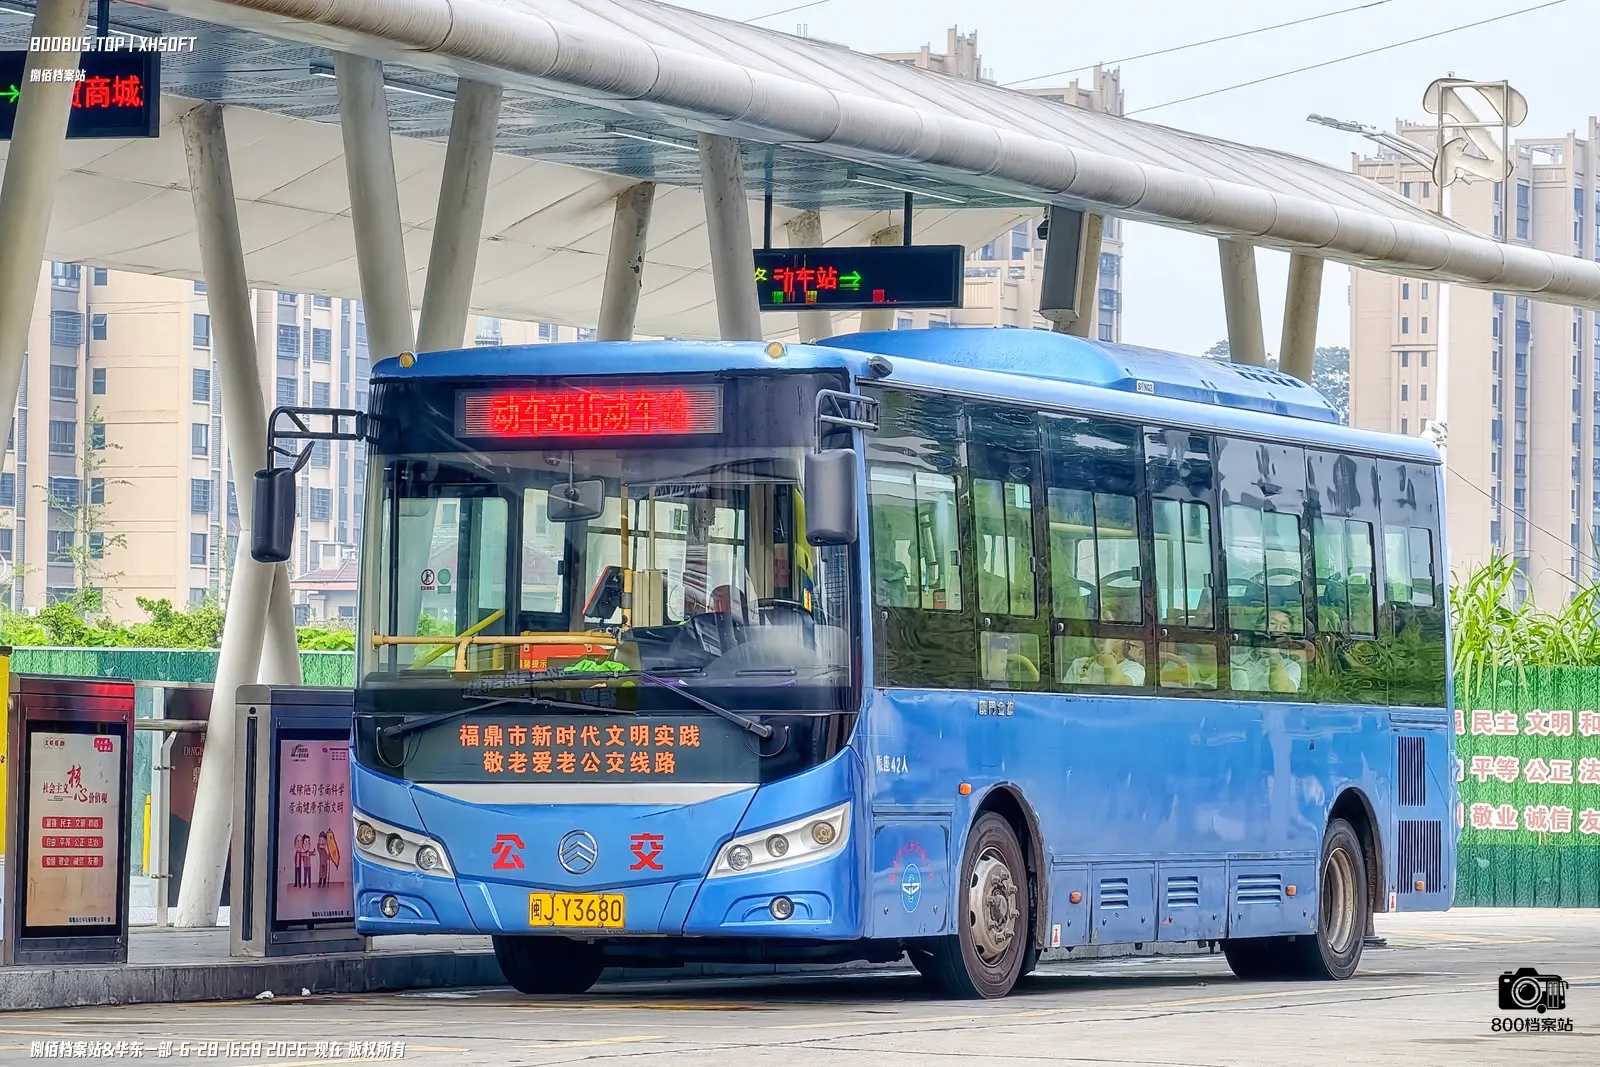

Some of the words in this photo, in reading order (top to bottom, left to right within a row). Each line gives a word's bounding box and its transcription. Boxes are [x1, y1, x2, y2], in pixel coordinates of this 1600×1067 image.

[773, 266, 837, 292] 动车站
[520, 659, 547, 669] 馨提示
[1473, 711, 1517, 733] 民主
[1527, 711, 1571, 733] 文明
[460, 725, 700, 747] 福鼎市新时代文明实践
[483, 752, 676, 774] 敬老爱老公交线路
[1472, 758, 1518, 780] 平等
[1526, 760, 1571, 782] 公正
[43, 782, 69, 794] 社会主义
[1472, 806, 1516, 828] 敬业
[1526, 807, 1571, 831] 诚信
[491, 834, 526, 870] 公
[629, 833, 664, 870] 交
